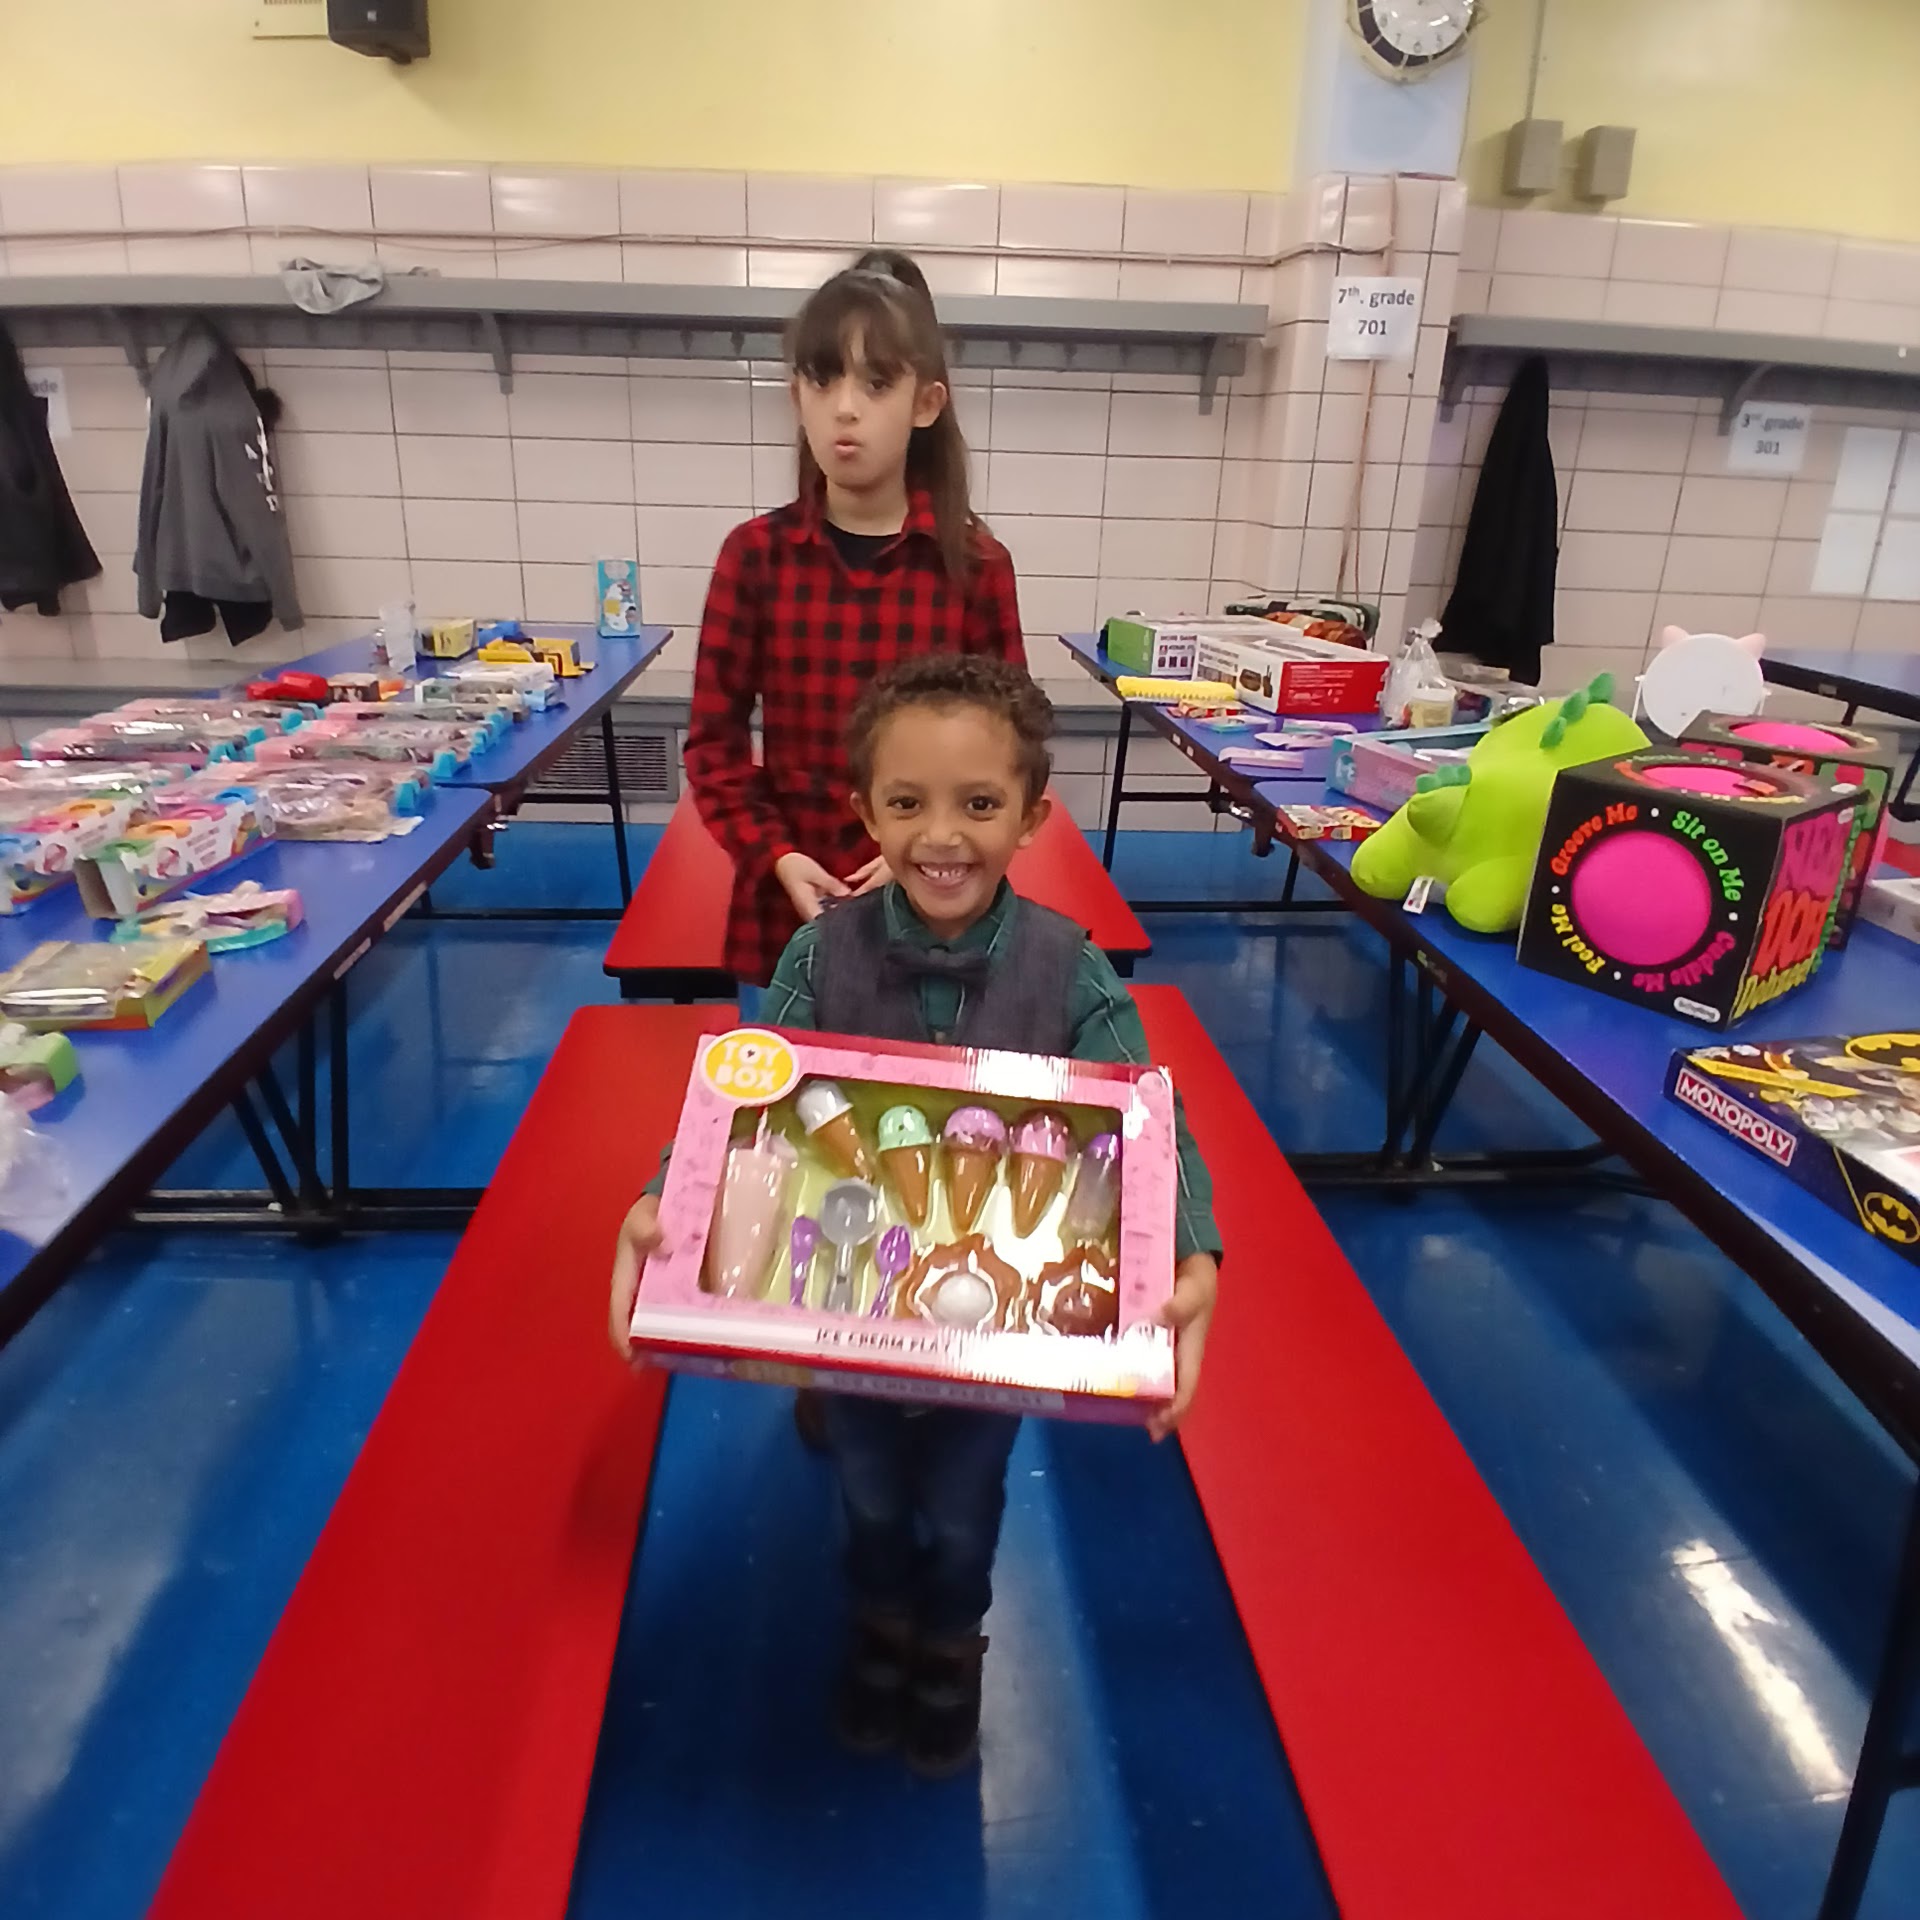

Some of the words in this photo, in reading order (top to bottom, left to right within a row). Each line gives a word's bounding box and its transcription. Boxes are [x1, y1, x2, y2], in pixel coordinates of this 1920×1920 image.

[1369, 290, 1415, 308] grade
[1358, 320, 1387, 336] 701
[1755, 440, 1780, 455] 301
[1551, 815, 1602, 876] Groove
[1605, 802, 1639, 826] Me
[1672, 810, 1706, 839] Sit
[1702, 838, 1729, 866] on
[1719, 867, 1744, 901] Me
[1550, 903, 1574, 935] Me
[1561, 934, 1606, 975] Feel
[1669, 931, 1736, 986] Cuddle
[1631, 972, 1665, 993] Me
[723, 1041, 783, 1067] TOY
[714, 1063, 776, 1092] BOX
[1680, 1073, 1792, 1157] MONOPOLY
[816, 1327, 841, 1346] ICE
[848, 1331, 905, 1351] CREAM
